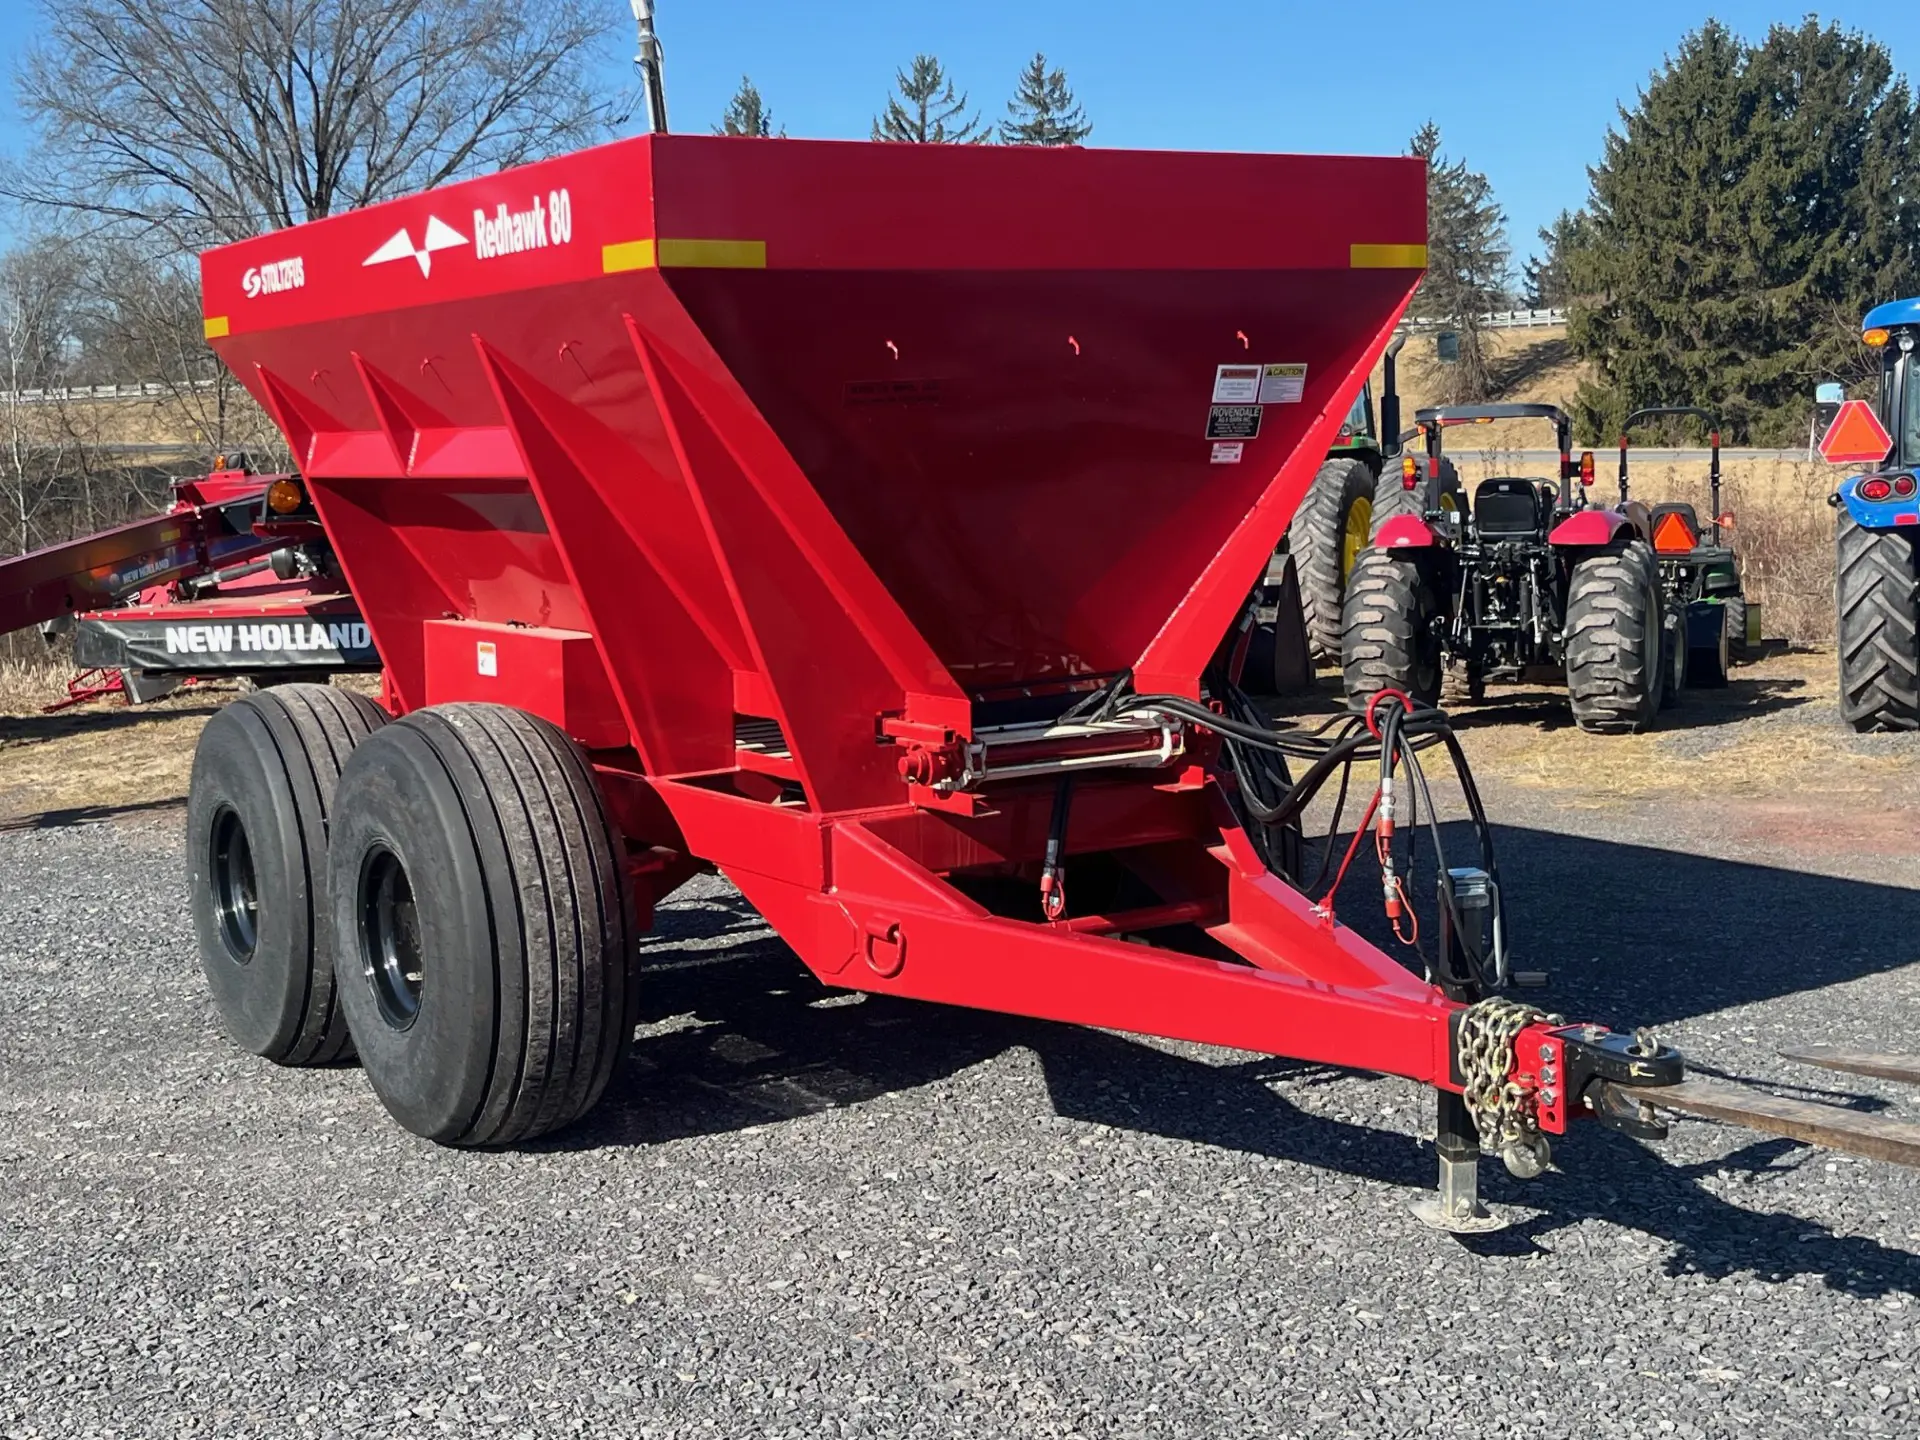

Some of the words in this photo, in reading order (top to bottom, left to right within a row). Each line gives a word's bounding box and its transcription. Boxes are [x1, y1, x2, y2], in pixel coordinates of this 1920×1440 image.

[473, 195, 548, 260] Redhawk
[549, 188, 572, 246] 80
[1212, 407, 1260, 418] ROVENDALE
[122, 569, 139, 585] NEW
[139, 558, 169, 578] HOLLAND
[165, 626, 233, 654] NEW
[238, 622, 372, 651] HOLLAND
